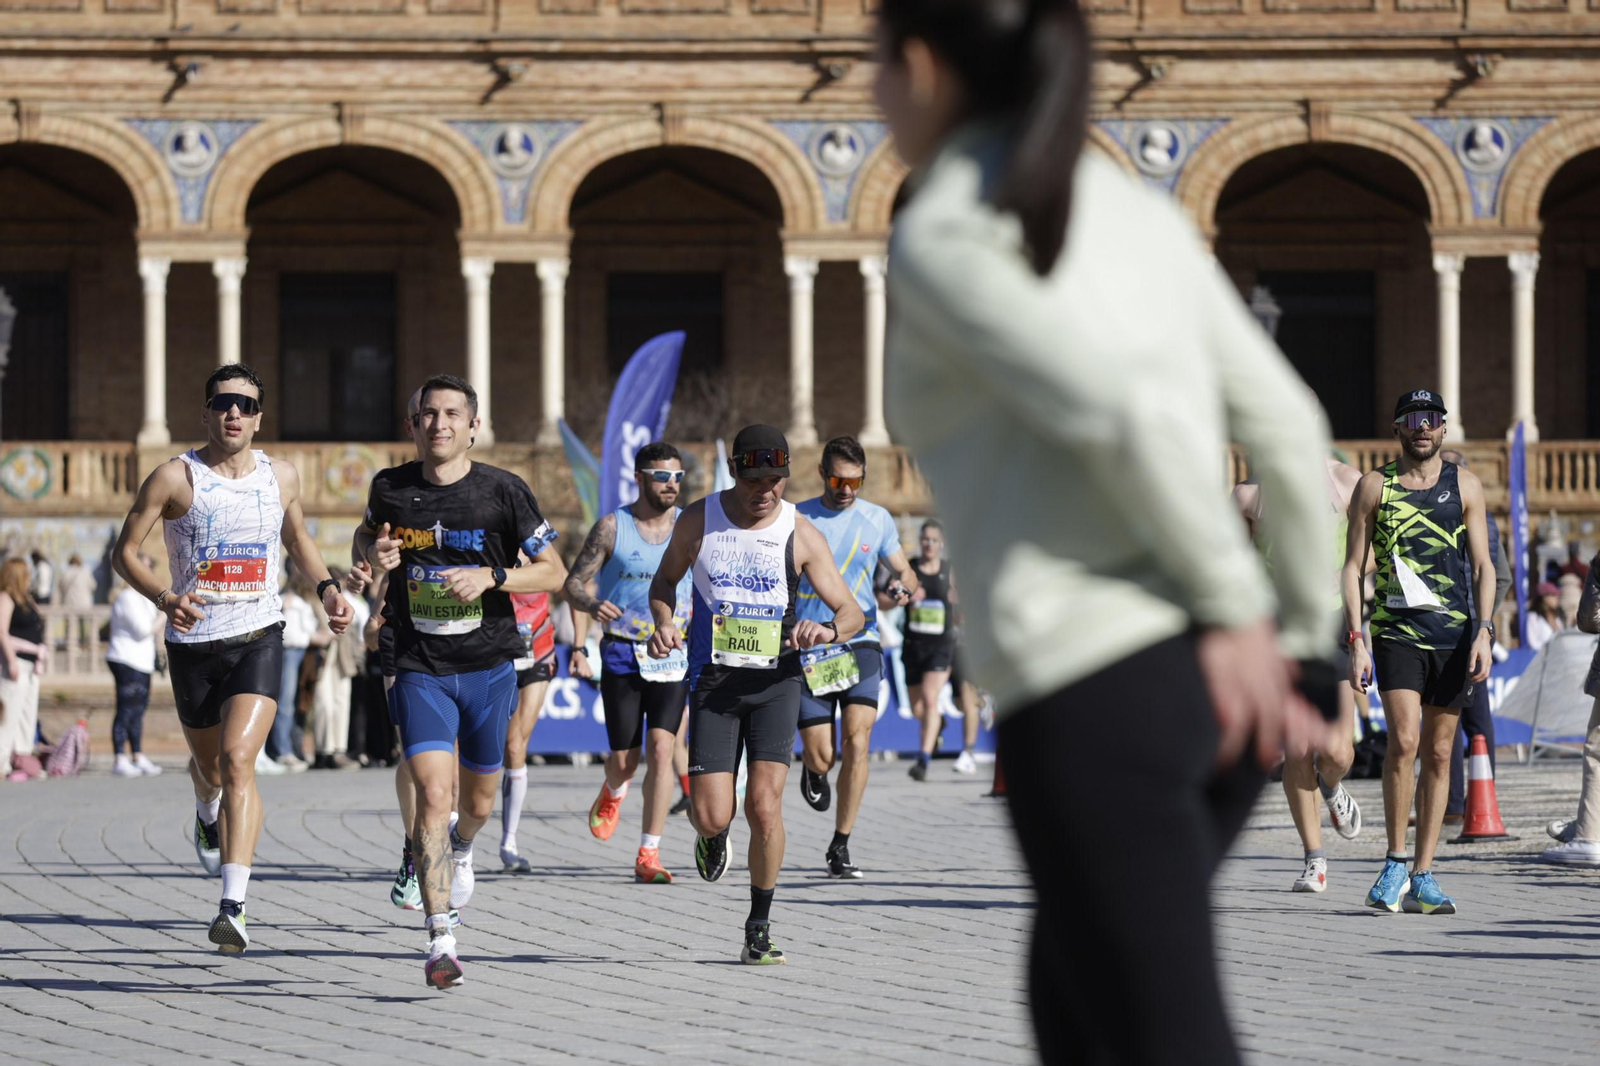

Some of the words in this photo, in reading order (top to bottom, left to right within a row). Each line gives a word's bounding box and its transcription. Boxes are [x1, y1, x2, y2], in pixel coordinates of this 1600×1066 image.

[709, 550, 781, 569] RUNNERS
[223, 565, 243, 574] 1128
[727, 559, 778, 579] Palmera
[197, 580, 228, 591] NACHO
[230, 579, 265, 591] MARTÍN
[410, 603, 432, 617] JAVI
[738, 625, 758, 635] 1948
[728, 636, 762, 652] RAÚL
